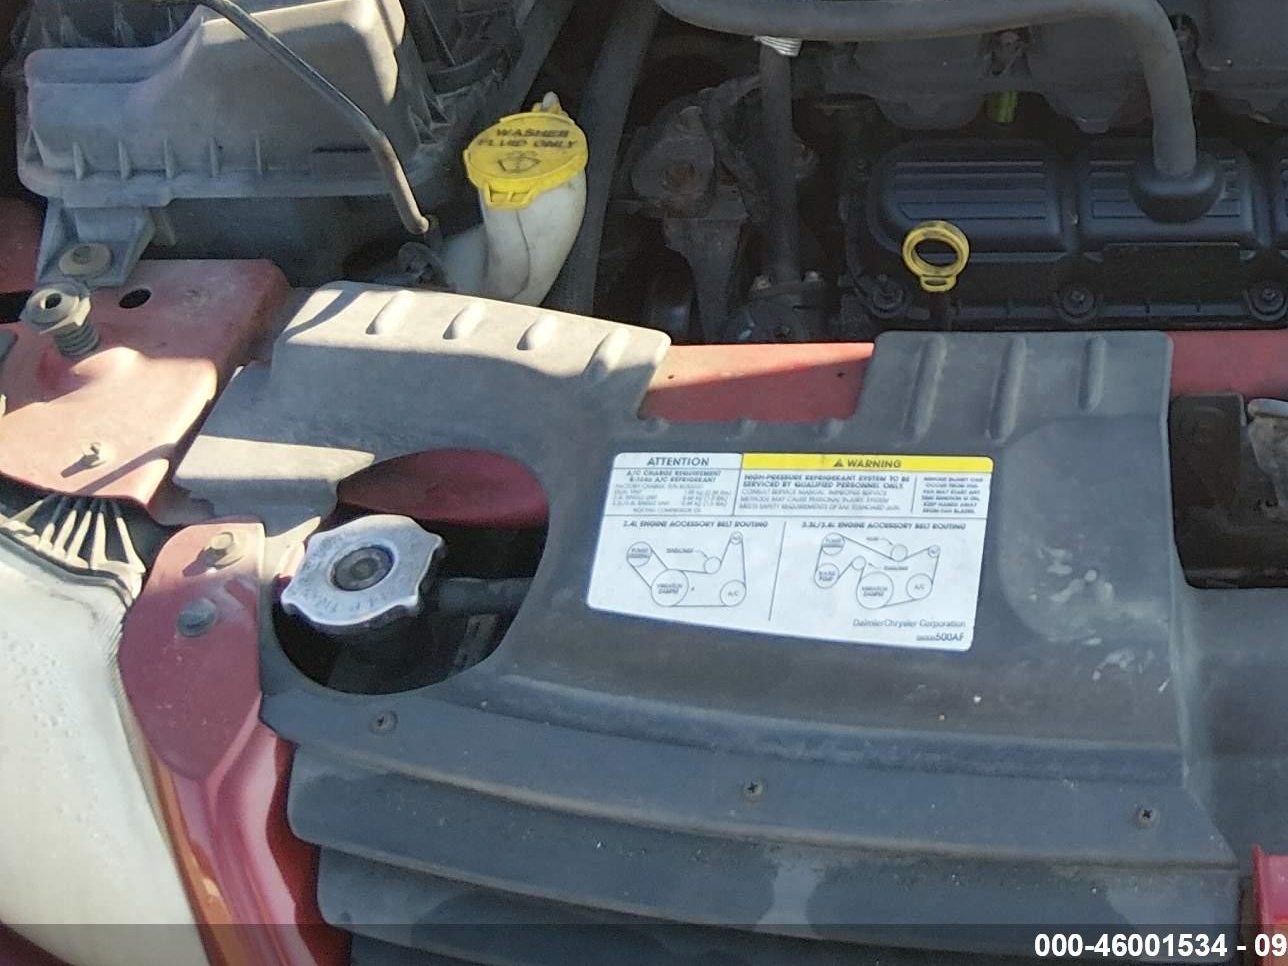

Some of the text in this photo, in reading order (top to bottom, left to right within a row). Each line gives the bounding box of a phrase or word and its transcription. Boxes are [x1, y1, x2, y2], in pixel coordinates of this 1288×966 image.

[497, 128, 570, 138] WASHER
[477, 139, 578, 148] FLUID ONLY
[646, 457, 710, 467] ATTENTION
[847, 459, 902, 469] WARNING
[919, 619, 966, 629] Corporation
